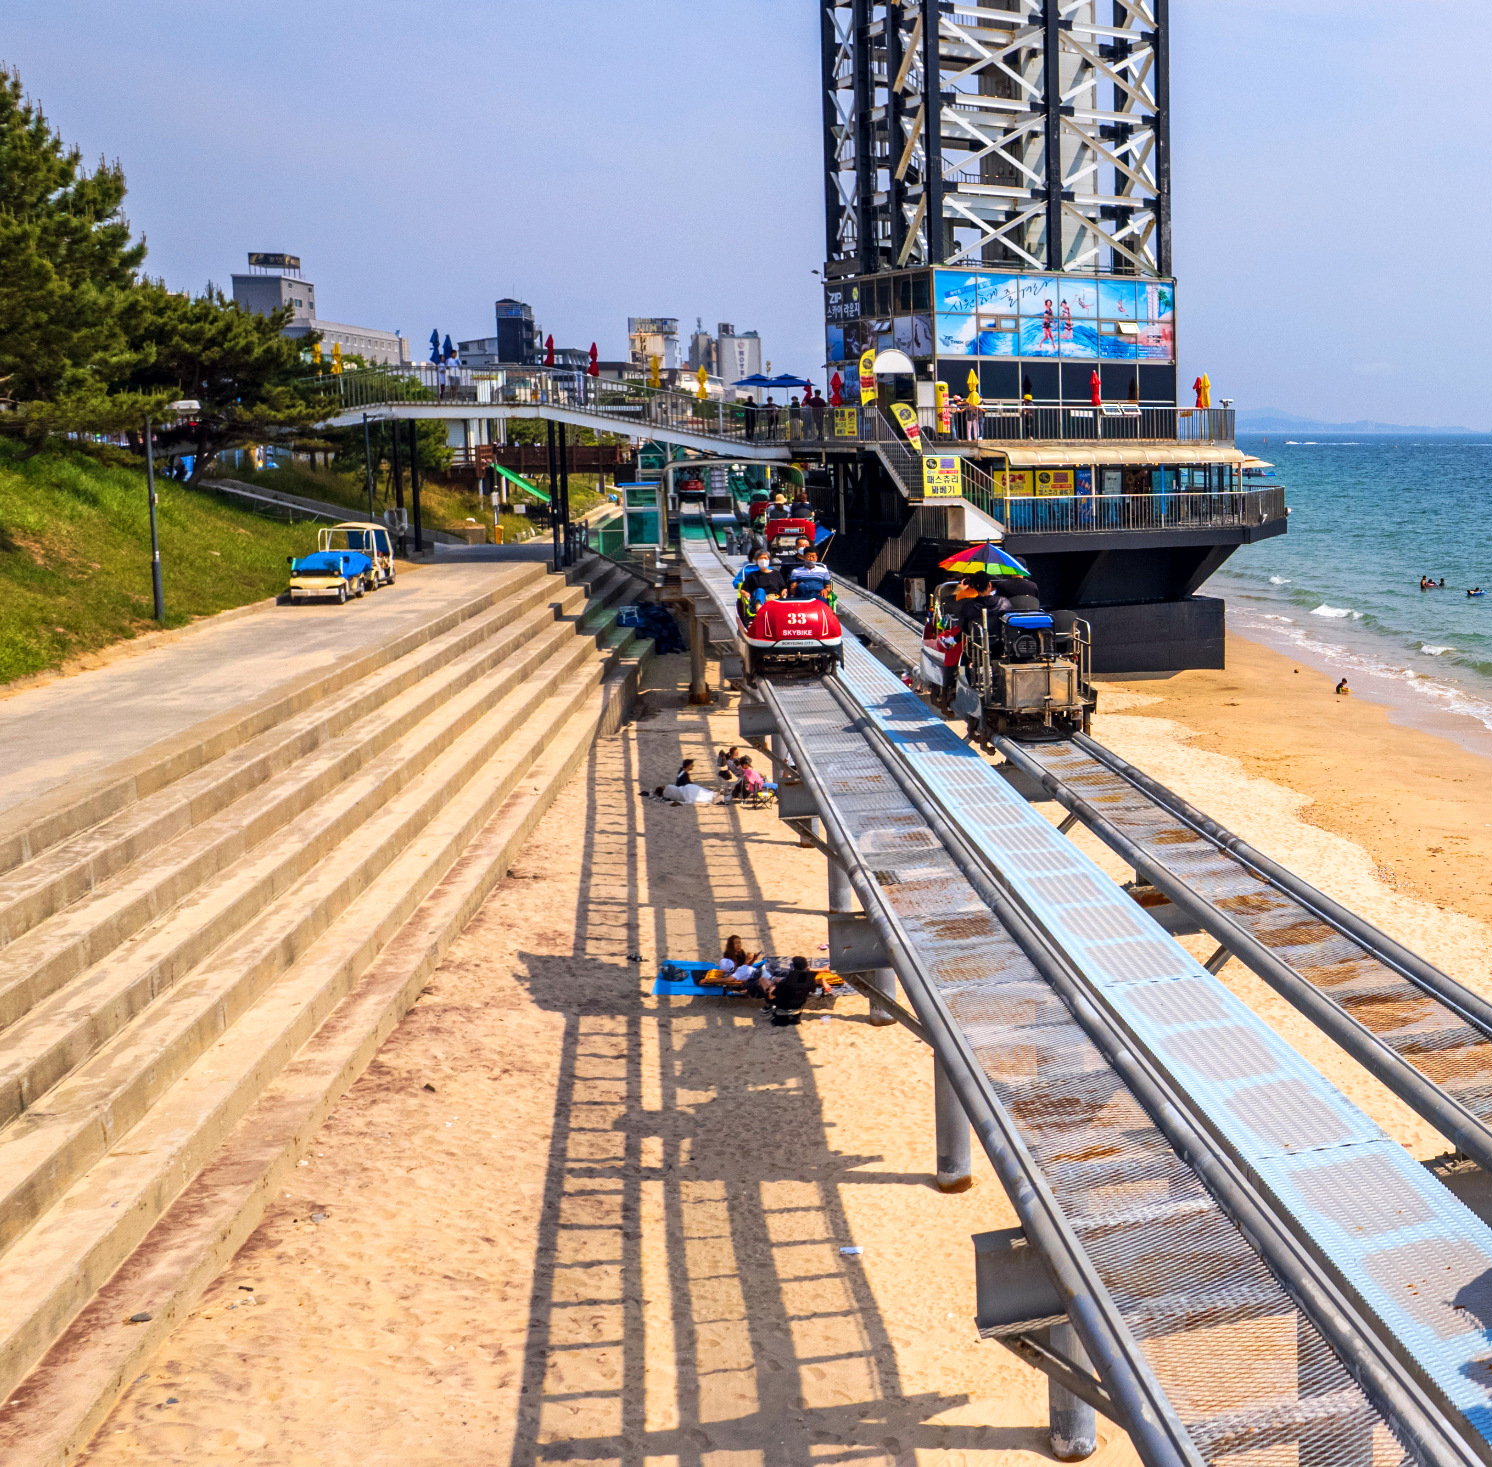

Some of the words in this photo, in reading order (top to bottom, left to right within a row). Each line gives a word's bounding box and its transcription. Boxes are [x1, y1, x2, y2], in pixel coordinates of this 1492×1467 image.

[827, 290, 842, 304] ZIP
[827, 304, 843, 319] 스카이
[843, 302, 860, 317] 라운지
[787, 612, 807, 625] 33
